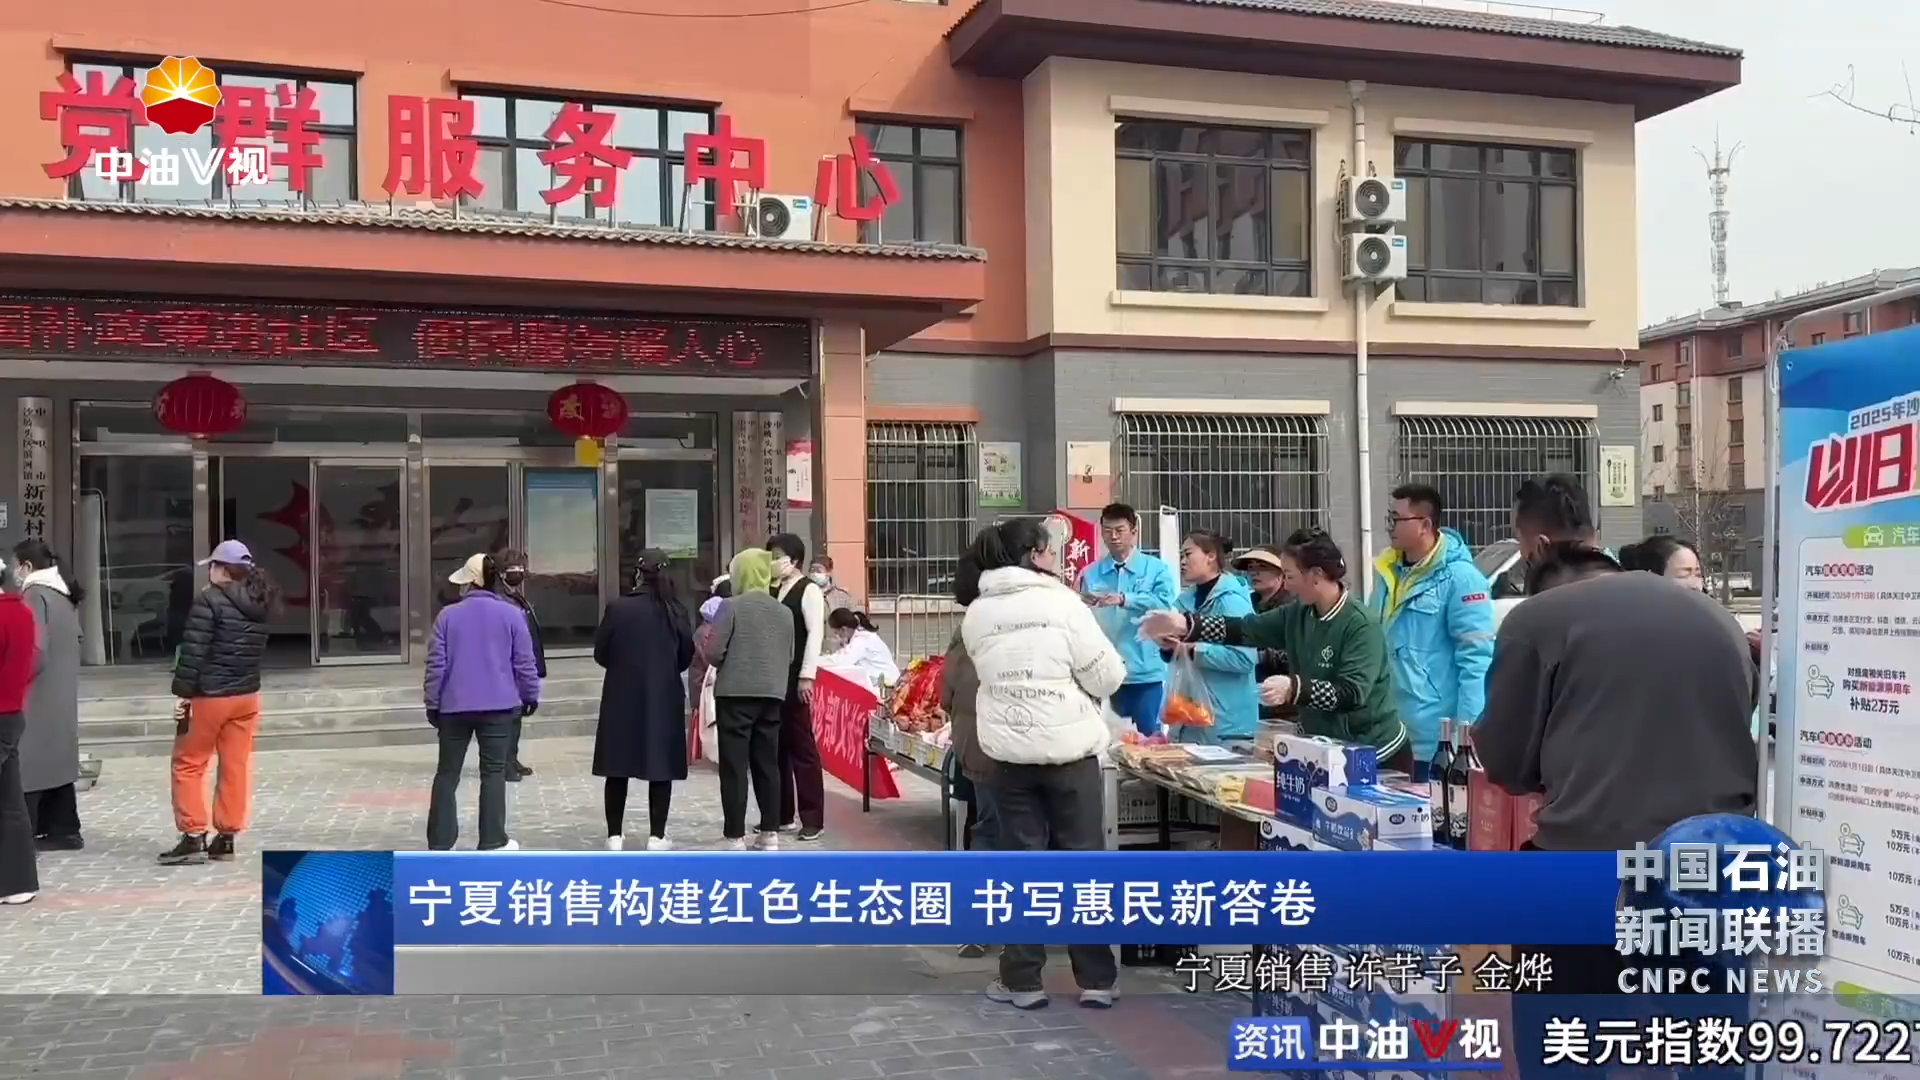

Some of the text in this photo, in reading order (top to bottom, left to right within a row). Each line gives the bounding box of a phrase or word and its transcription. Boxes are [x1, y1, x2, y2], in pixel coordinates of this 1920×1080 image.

[40, 70, 902, 222] 党群服务中心
[1850, 397, 1919, 430] 2025年沙
[1805, 422, 1913, 509] 以旧
[24, 483, 46, 543] 新墩村
[1892, 525, 1920, 545] 汽车
[1850, 697, 1900, 715] 补贴2万元
[1276, 771, 1305, 796] 纯牛奶
